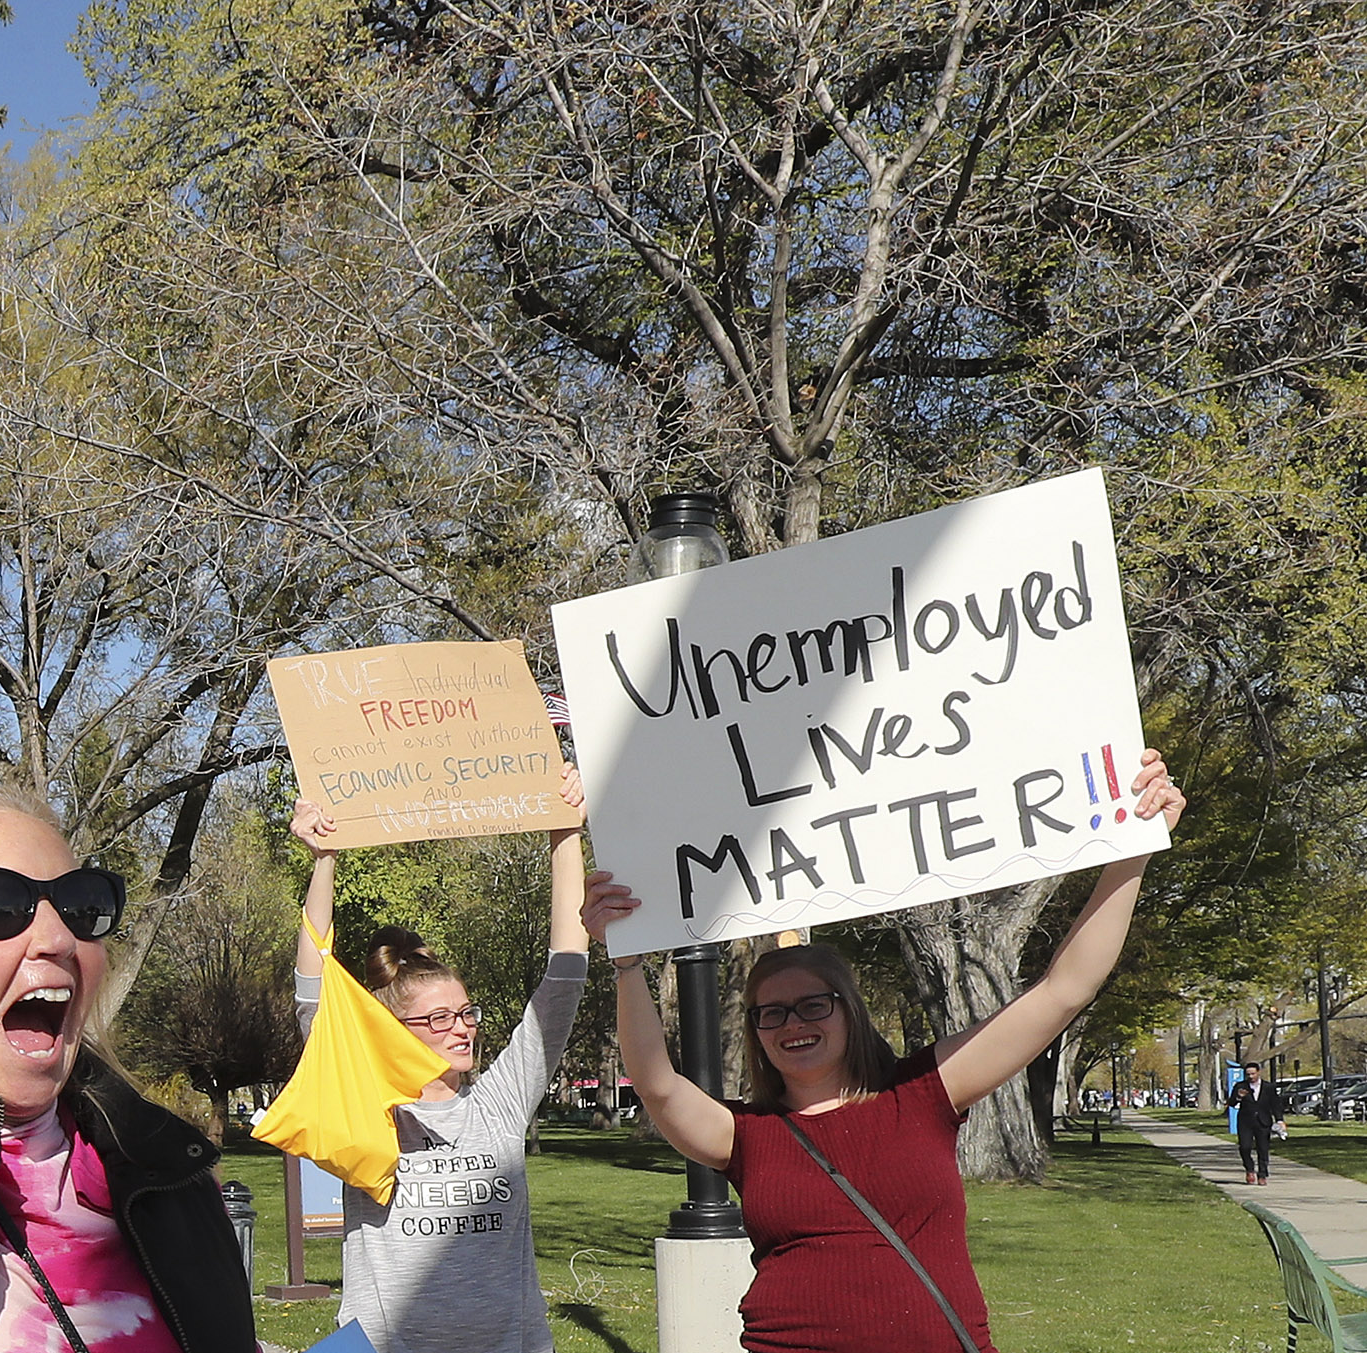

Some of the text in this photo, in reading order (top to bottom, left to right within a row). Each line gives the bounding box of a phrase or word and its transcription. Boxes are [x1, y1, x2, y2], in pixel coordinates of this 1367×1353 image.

[604, 540, 1093, 723] Unemployed
[283, 654, 511, 711] TRUE Individual
[359, 696, 479, 737] FREEDOM
[403, 730, 453, 750] exist
[318, 752, 551, 806] ECONOMIC SECURITY
[423, 785, 463, 804] AND
[675, 743, 1127, 920] MATTER!!
[394, 1175, 513, 1209] NEEDS
[401, 1212, 503, 1237] COFFEE
